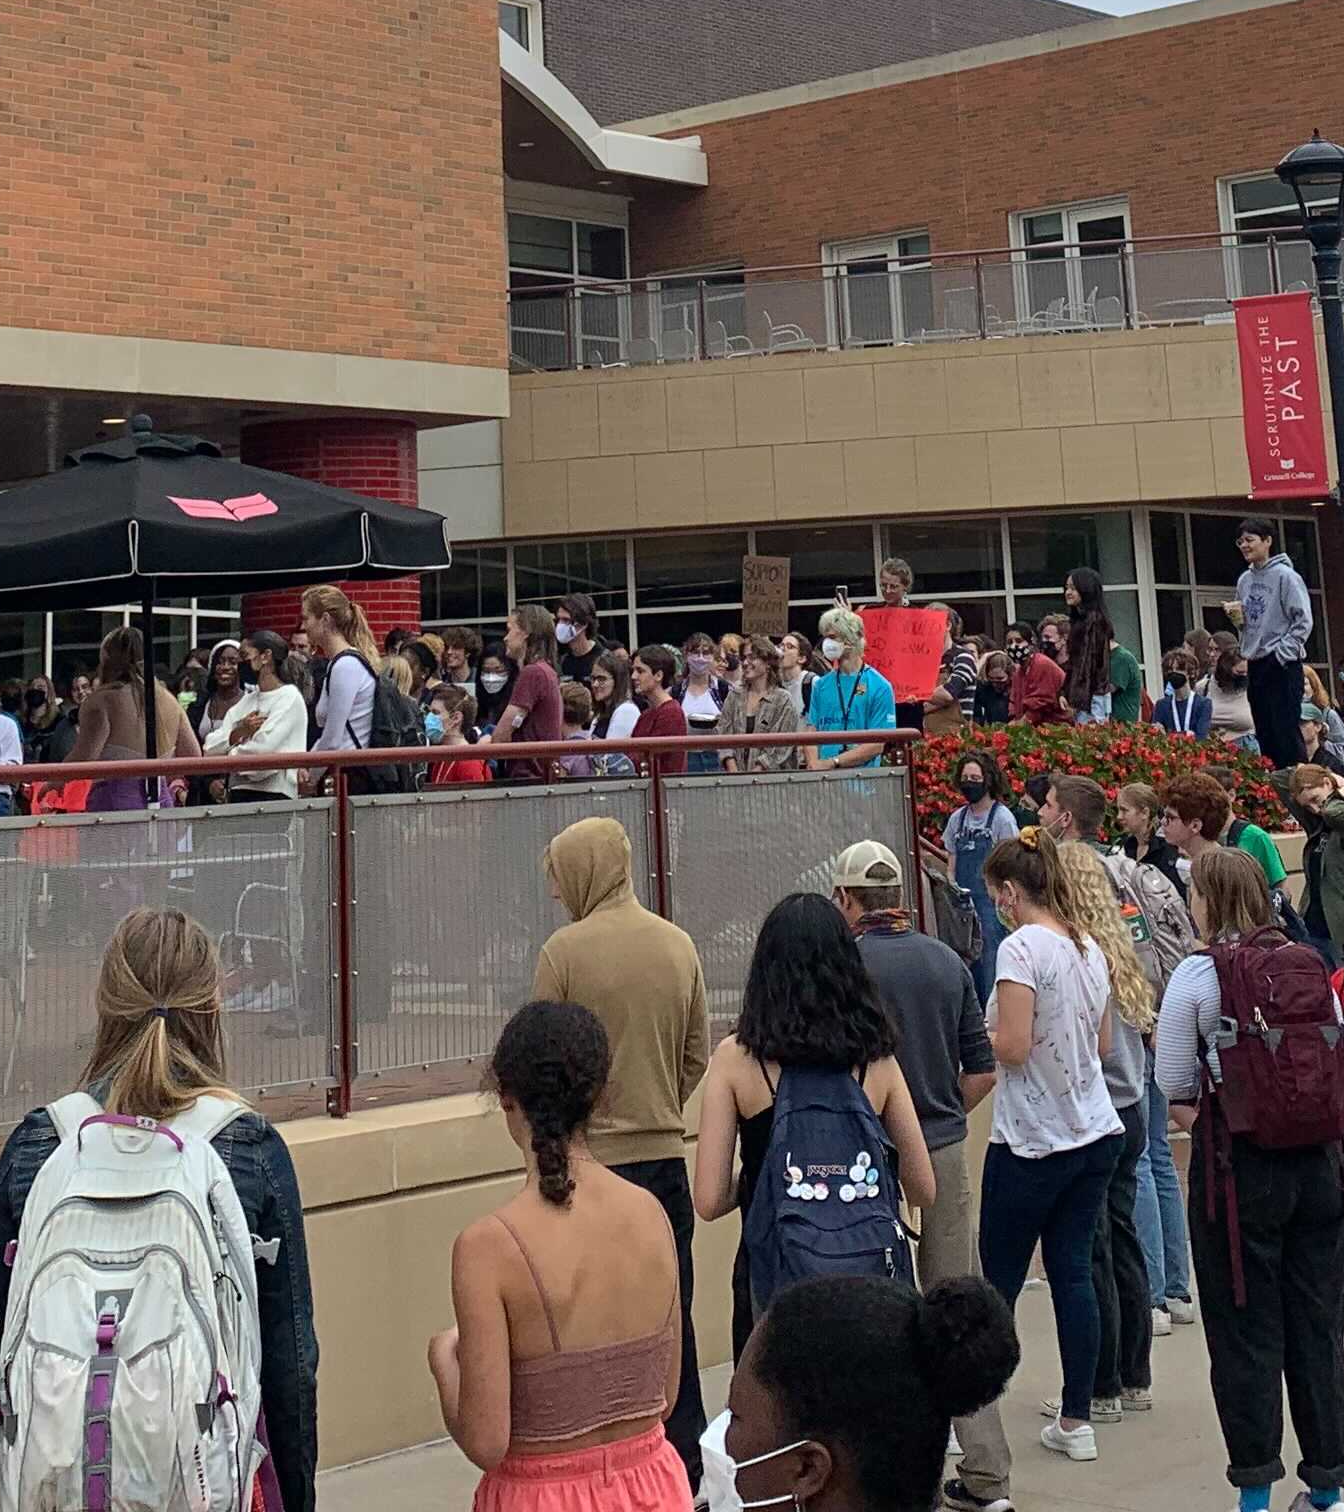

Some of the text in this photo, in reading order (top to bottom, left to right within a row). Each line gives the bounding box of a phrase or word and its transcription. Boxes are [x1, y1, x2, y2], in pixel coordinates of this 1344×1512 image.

[1258, 316, 1280, 457] SCRUTINIZE THE
[1275, 336, 1305, 421] PAST
